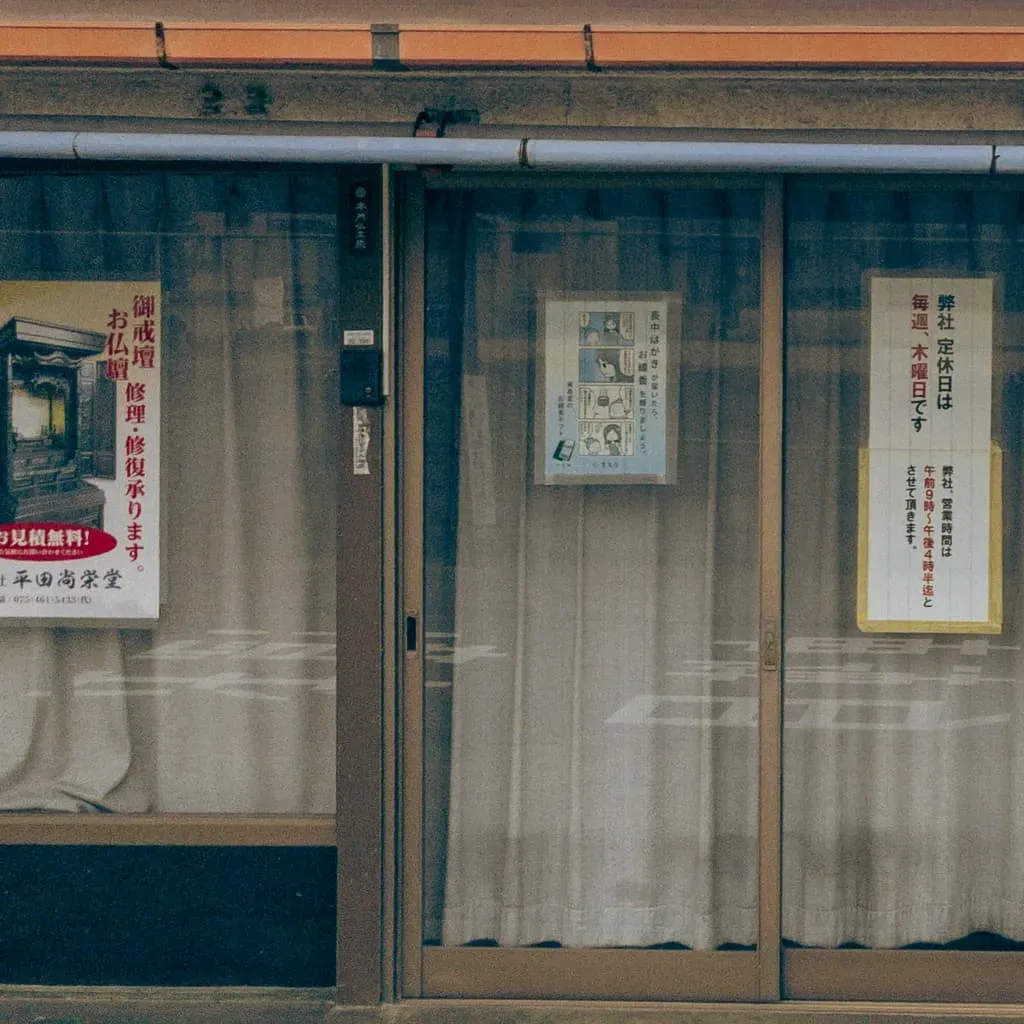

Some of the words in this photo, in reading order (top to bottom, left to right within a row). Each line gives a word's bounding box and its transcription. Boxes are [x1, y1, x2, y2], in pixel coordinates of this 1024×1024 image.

[107, 308, 129, 381] お仏壇
[132, 295, 155, 369] 御戒壇
[13, 568, 122, 589] 平田尚栄堂
